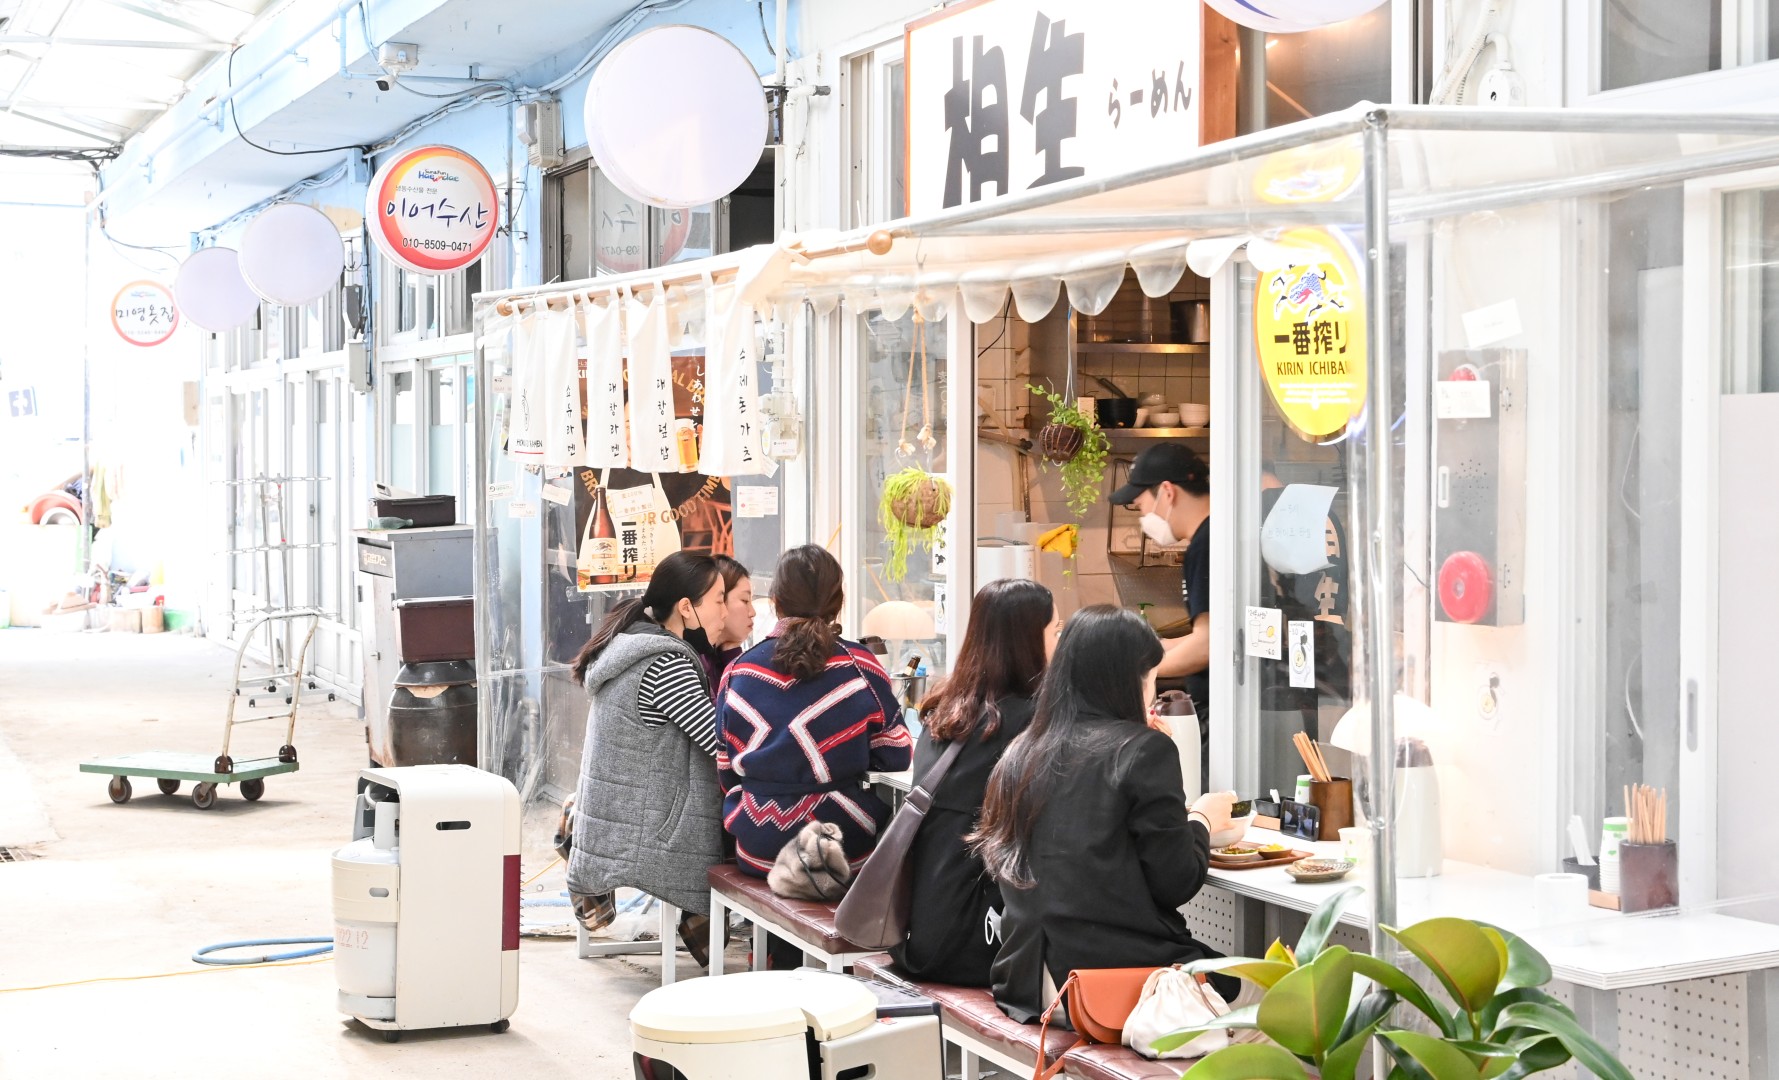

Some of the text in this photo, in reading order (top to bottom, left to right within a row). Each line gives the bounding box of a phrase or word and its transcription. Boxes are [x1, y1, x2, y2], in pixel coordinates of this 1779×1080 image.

[1108, 60, 1192, 129] らーめん
[387, 198, 488, 228] 이어수산
[402, 238, 472, 252] 010-8509-0471
[1274, 320, 1348, 355] 一番搾り
[1276, 362, 1304, 376] KIRIN
[565, 385, 576, 456] 쇼유라멘
[739, 348, 752, 461] 수제돈가츠
[661, 499, 697, 523] GOOD
[621, 521, 639, 580] 一番搾り
